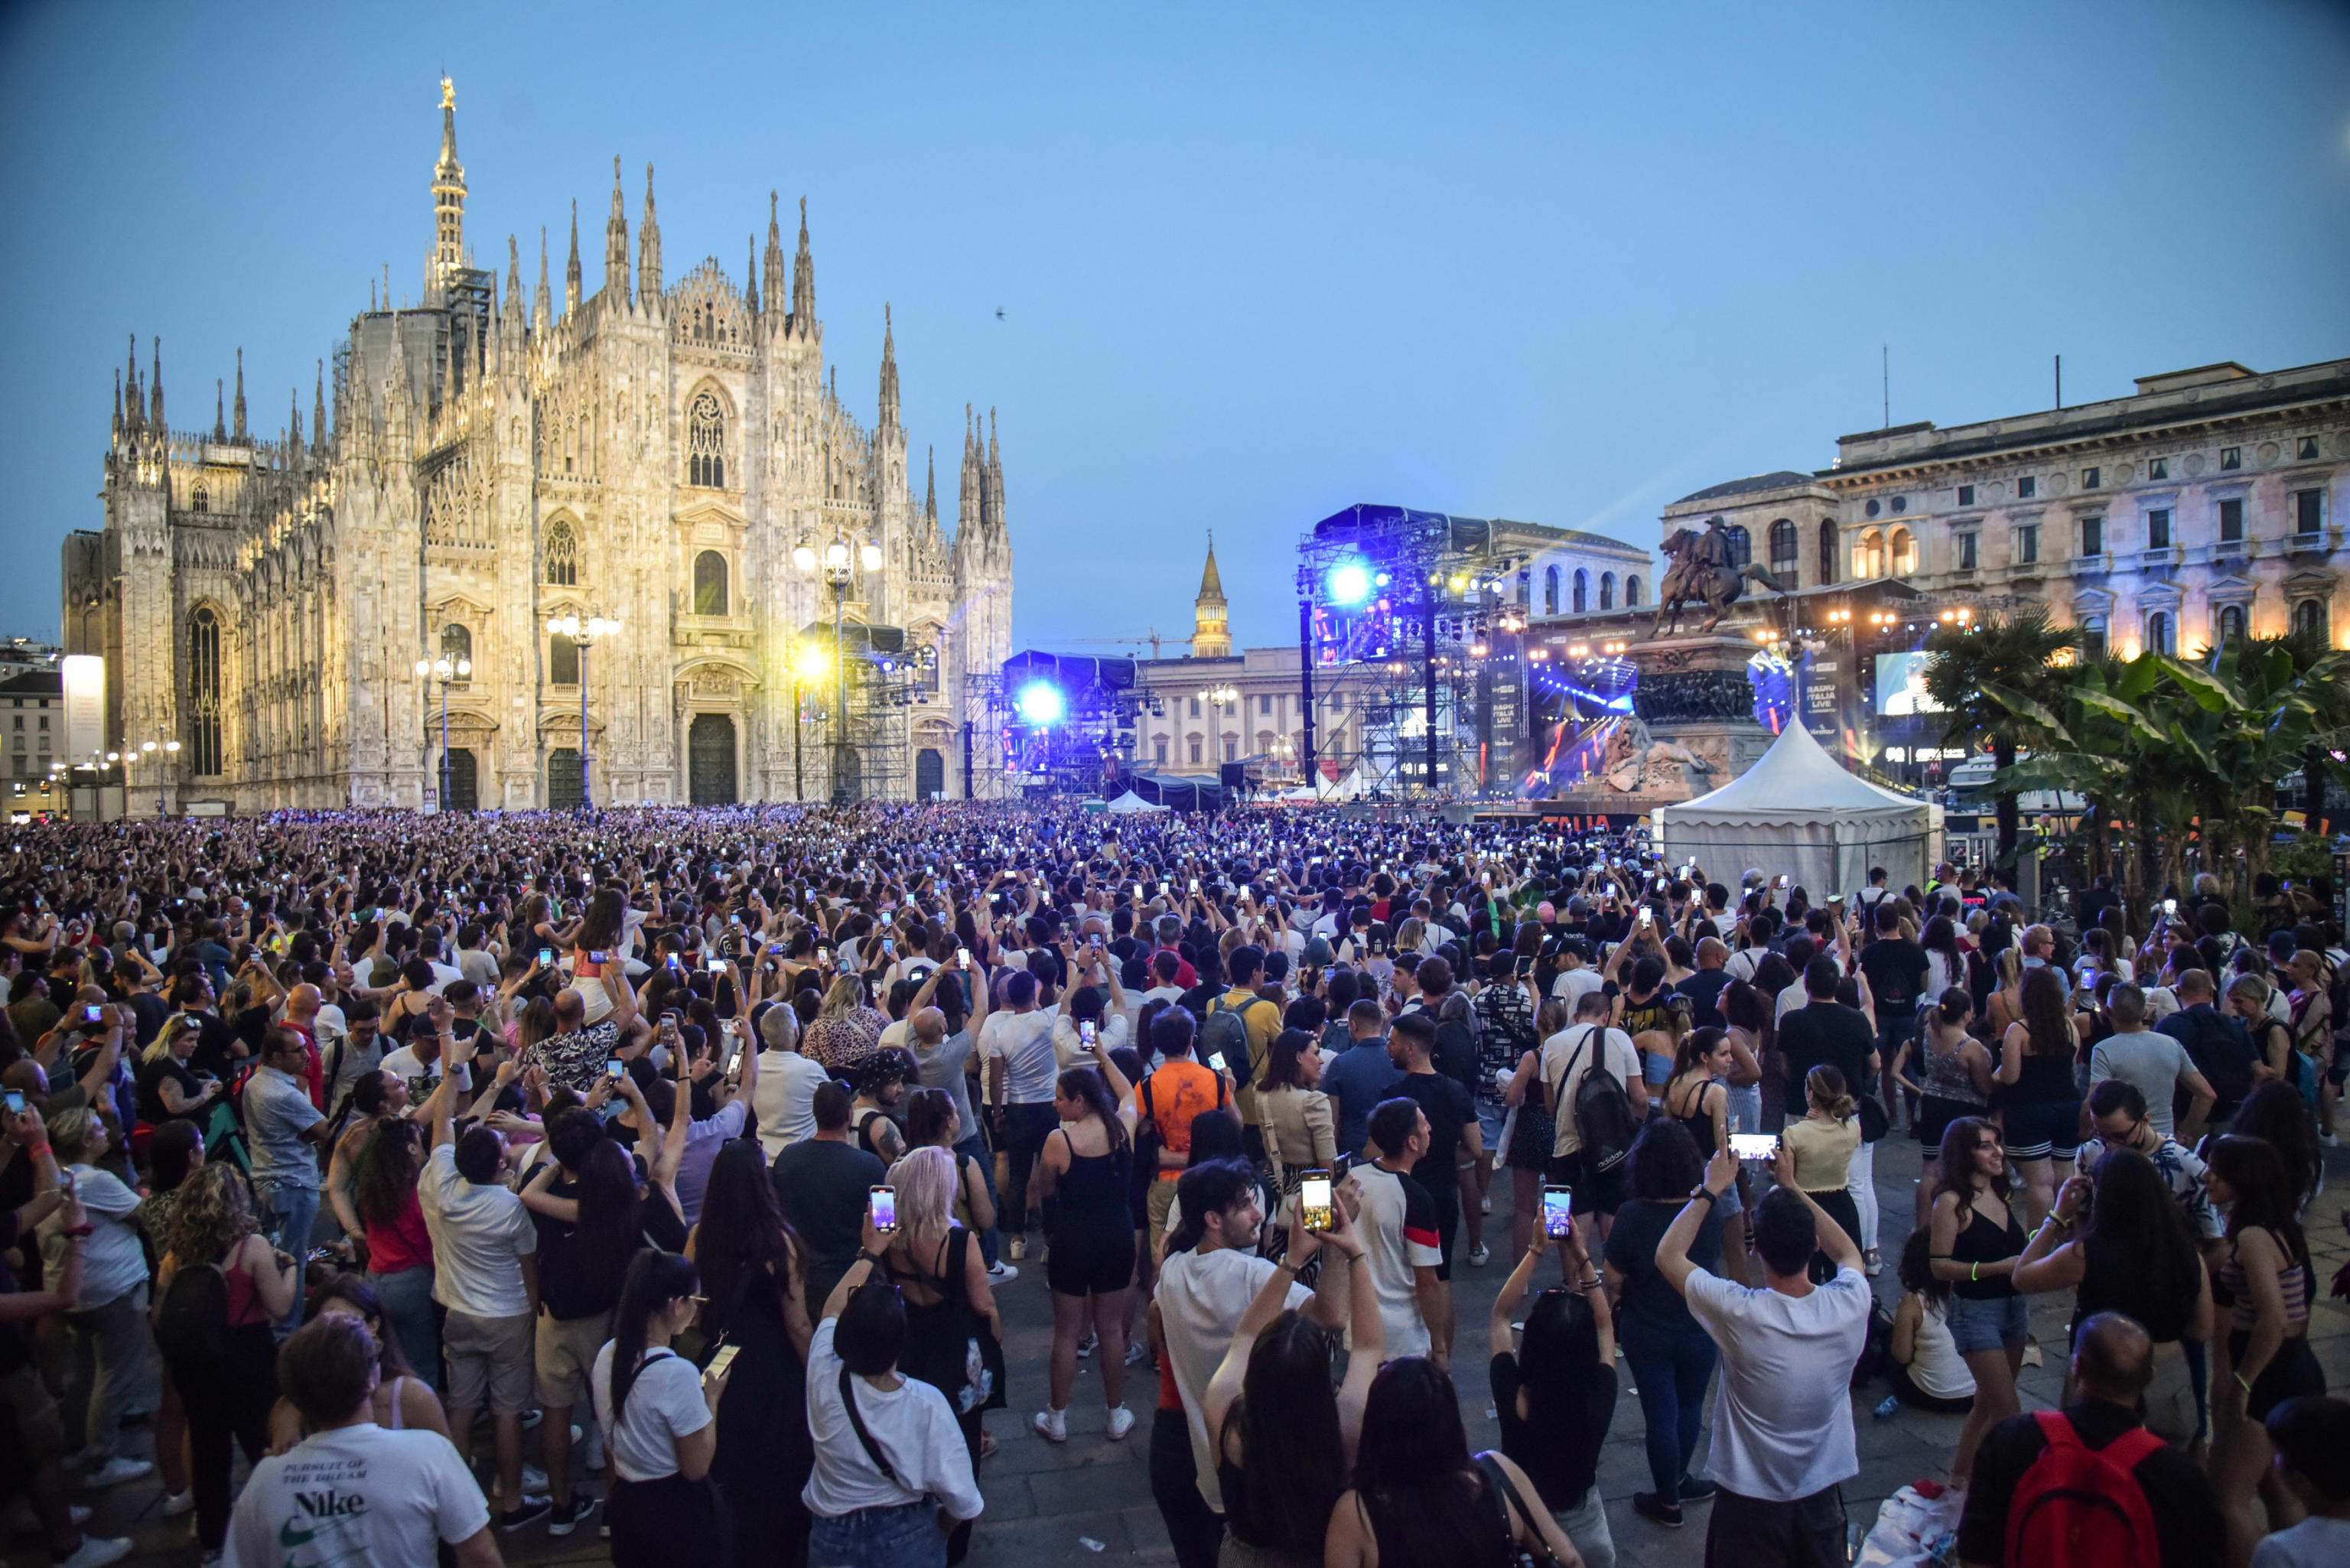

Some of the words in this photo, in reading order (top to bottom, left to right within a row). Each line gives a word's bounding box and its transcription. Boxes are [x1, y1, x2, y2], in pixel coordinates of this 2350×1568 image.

[1806, 685, 1836, 693] RADIO
[1806, 691, 1836, 701] ITALIA
[1106, 762, 1115, 774] M
[425, 790, 435, 799] M
[1597, 1150, 1623, 1168] adidas
[285, 1462, 342, 1472] PURSUIT
[347, 1459, 366, 1469] OF
[283, 1474, 310, 1483] THE
[315, 1470, 367, 1482] DREAM
[295, 1490, 364, 1518] Nike
